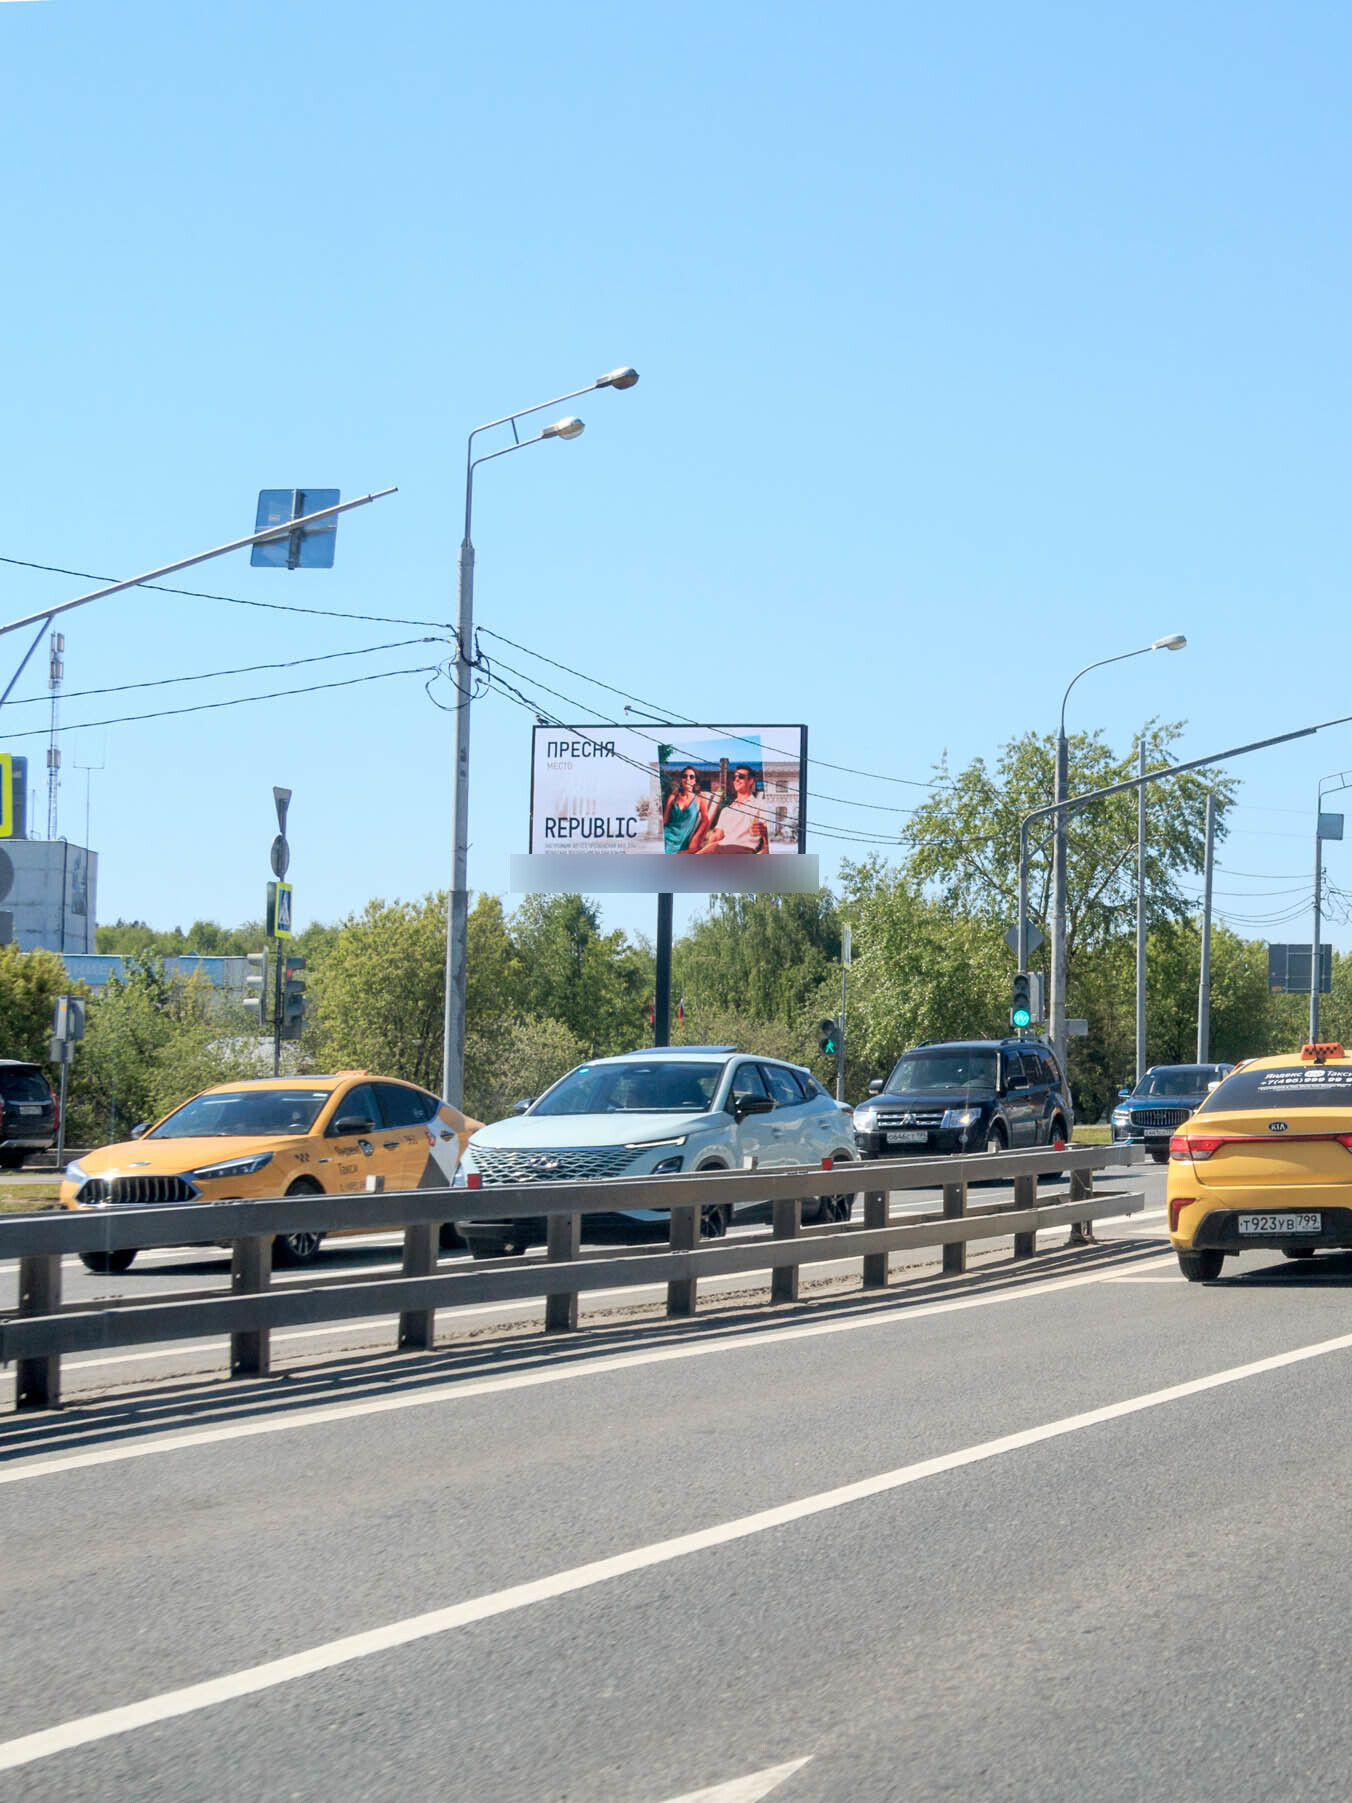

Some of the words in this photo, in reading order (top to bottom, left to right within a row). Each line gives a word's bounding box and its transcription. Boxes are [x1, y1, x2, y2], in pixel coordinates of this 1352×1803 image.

[547, 741, 615, 758] ПРЕСНЯ
[547, 762, 573, 770] МЕСТО
[545, 817, 638, 838] REPUBLIC
[1243, 1216, 1295, 1231] Т923УВ
[1296, 1214, 1317, 1226] 799
